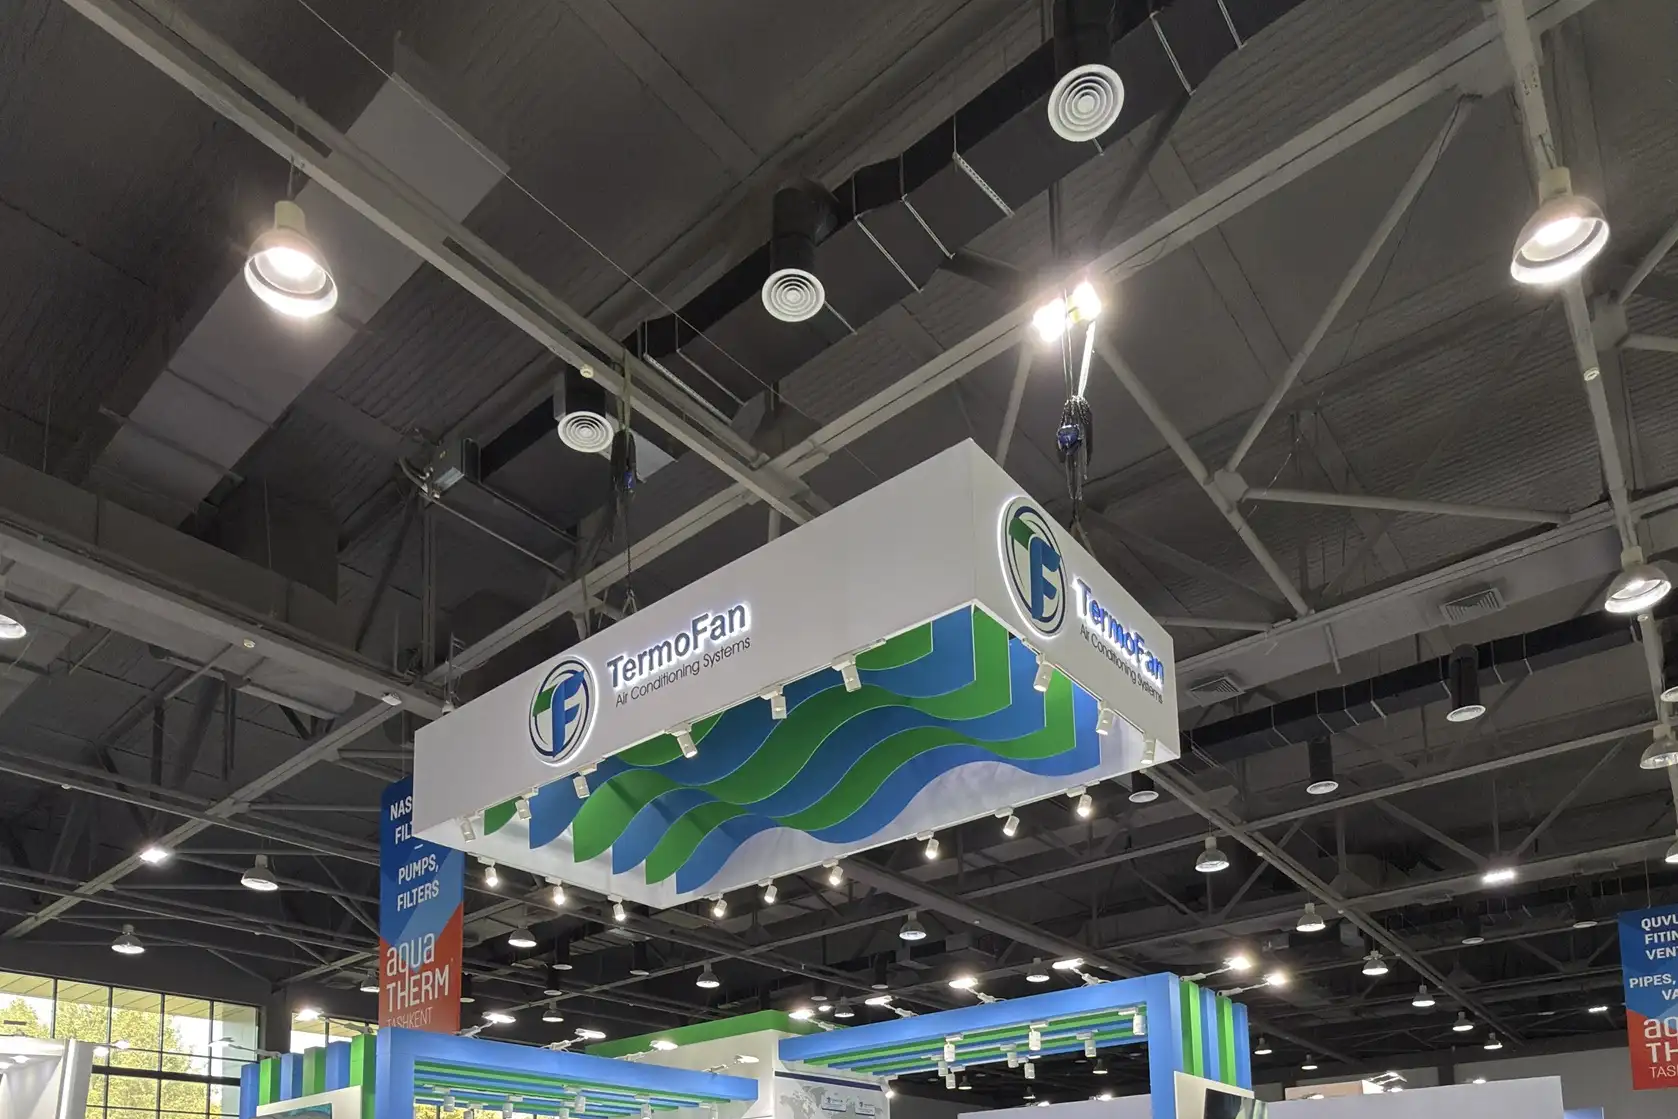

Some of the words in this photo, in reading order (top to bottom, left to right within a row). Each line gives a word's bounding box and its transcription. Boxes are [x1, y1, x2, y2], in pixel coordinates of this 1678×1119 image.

[606, 603, 748, 688] TermoFan
[1075, 577, 1165, 685] TermoFan
[615, 691, 628, 708] Air
[630, 659, 701, 701] Conditioning
[702, 637, 751, 669] Systems
[1080, 624, 1090, 642] Air
[1091, 636, 1137, 685] Conditioning
[1137, 673, 1164, 705] Systems
[398, 853, 439, 885] PUMPS,
[397, 879, 440, 912] FILTERS
[386, 932, 435, 979] aqua
[1645, 945, 1678, 961] VEN
[386, 963, 450, 1013] THERM
[1629, 972, 1677, 989] PIPES,
[1649, 1064, 1678, 1079] TAS
